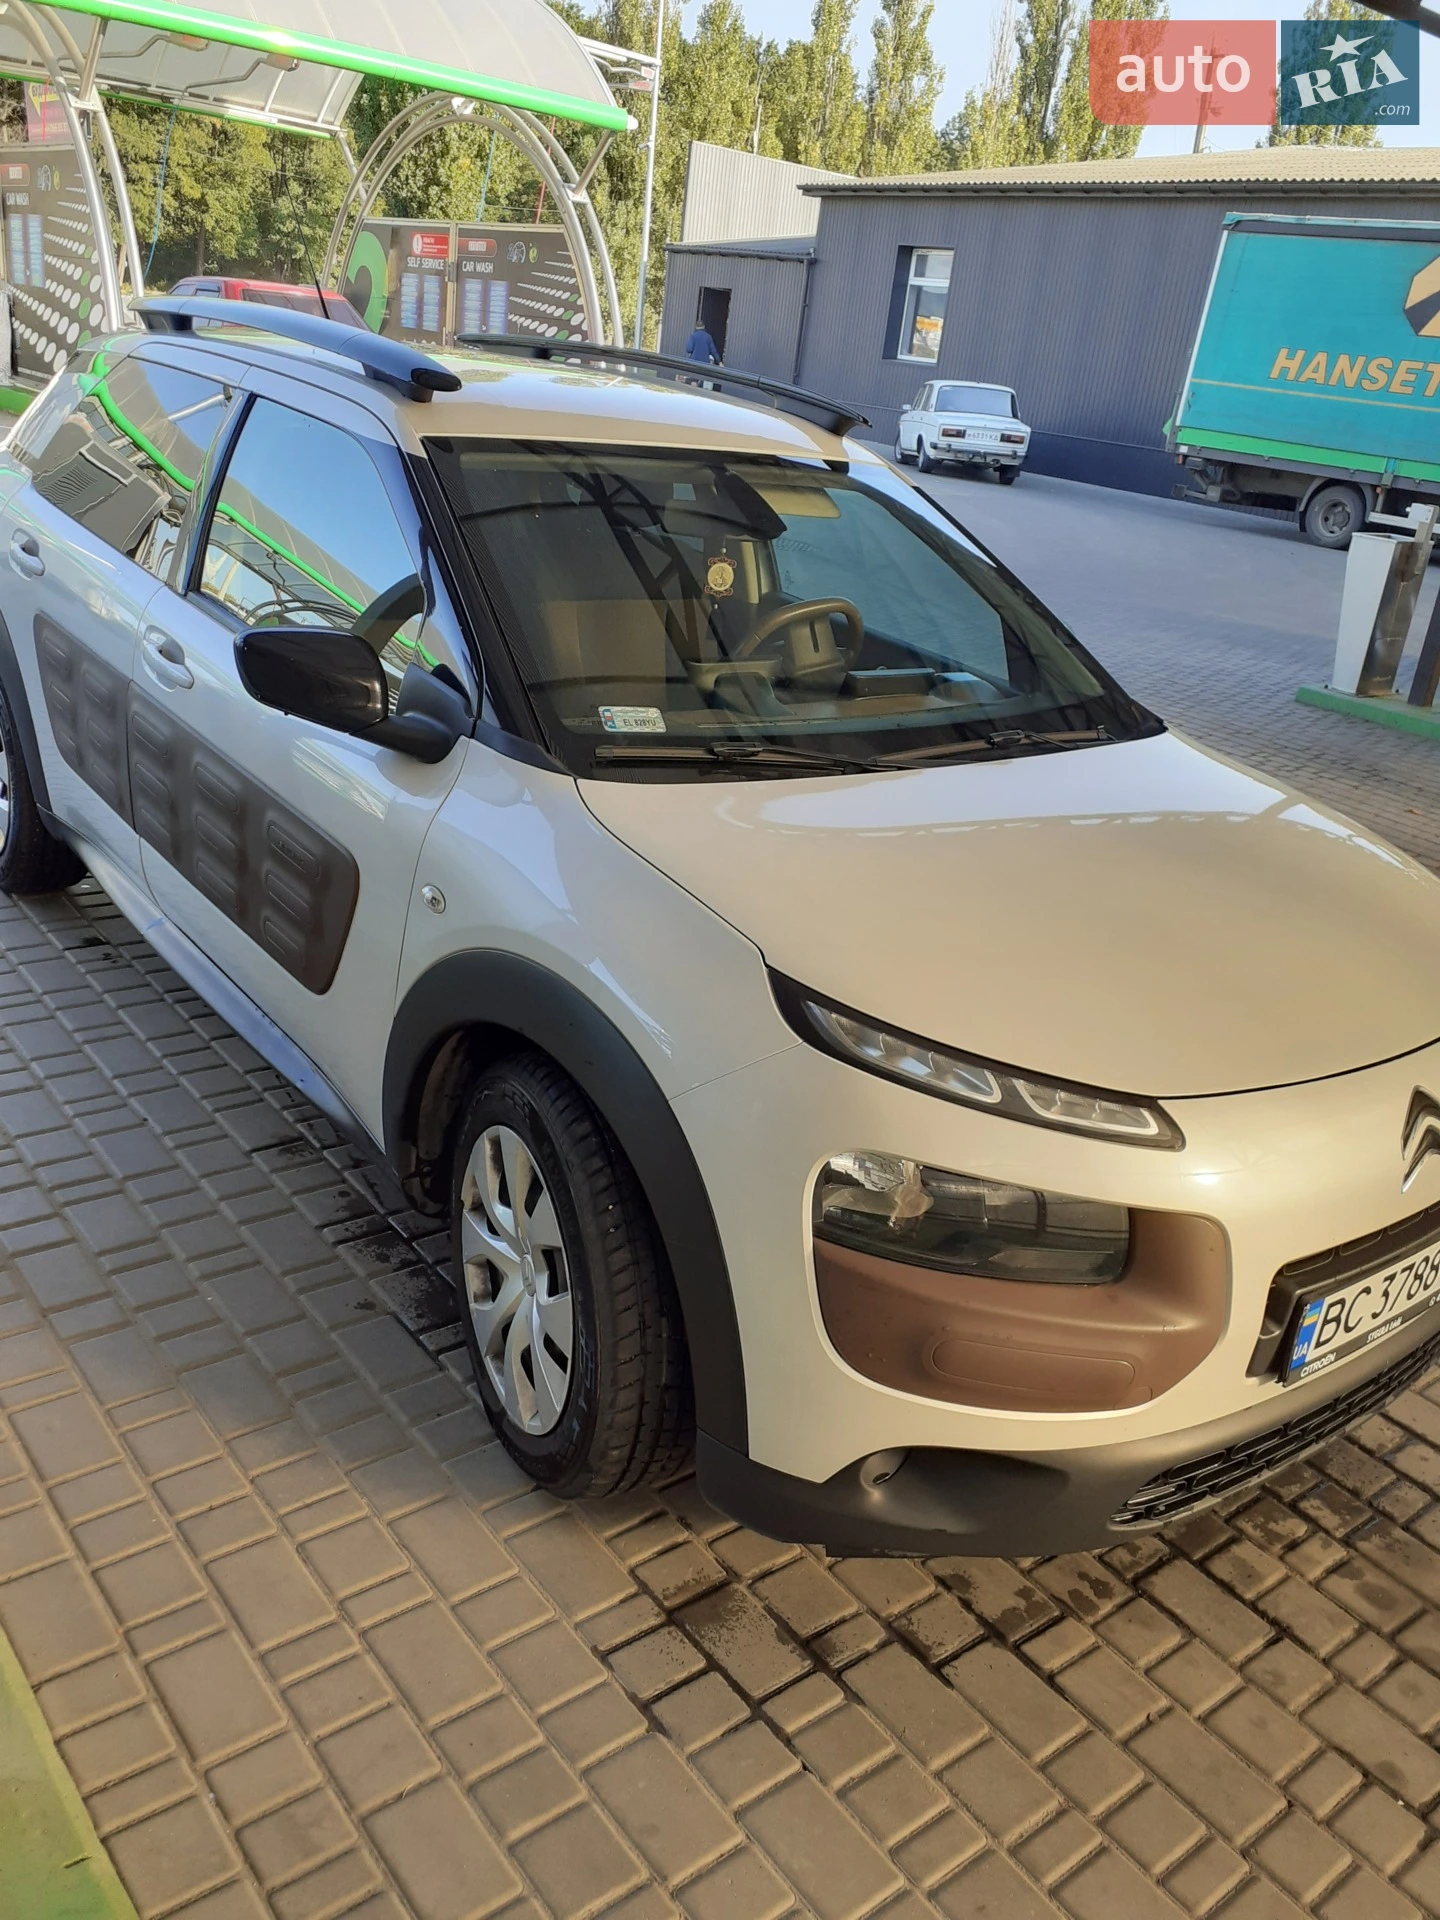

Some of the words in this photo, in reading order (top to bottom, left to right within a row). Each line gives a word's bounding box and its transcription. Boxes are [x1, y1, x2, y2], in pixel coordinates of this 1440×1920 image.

[407, 256, 421, 268] SELF
[422, 257, 445, 270] SERVICE
[462, 261, 475, 272] CAR
[475, 262, 494, 273] WASH
[1269, 347, 1440, 398] HANSET
[623, 718, 634, 727] EL
[1314, 1286, 1372, 1350] BC
[1371, 1249, 1440, 1320] 3788
[1293, 1345, 1309, 1360] UA
